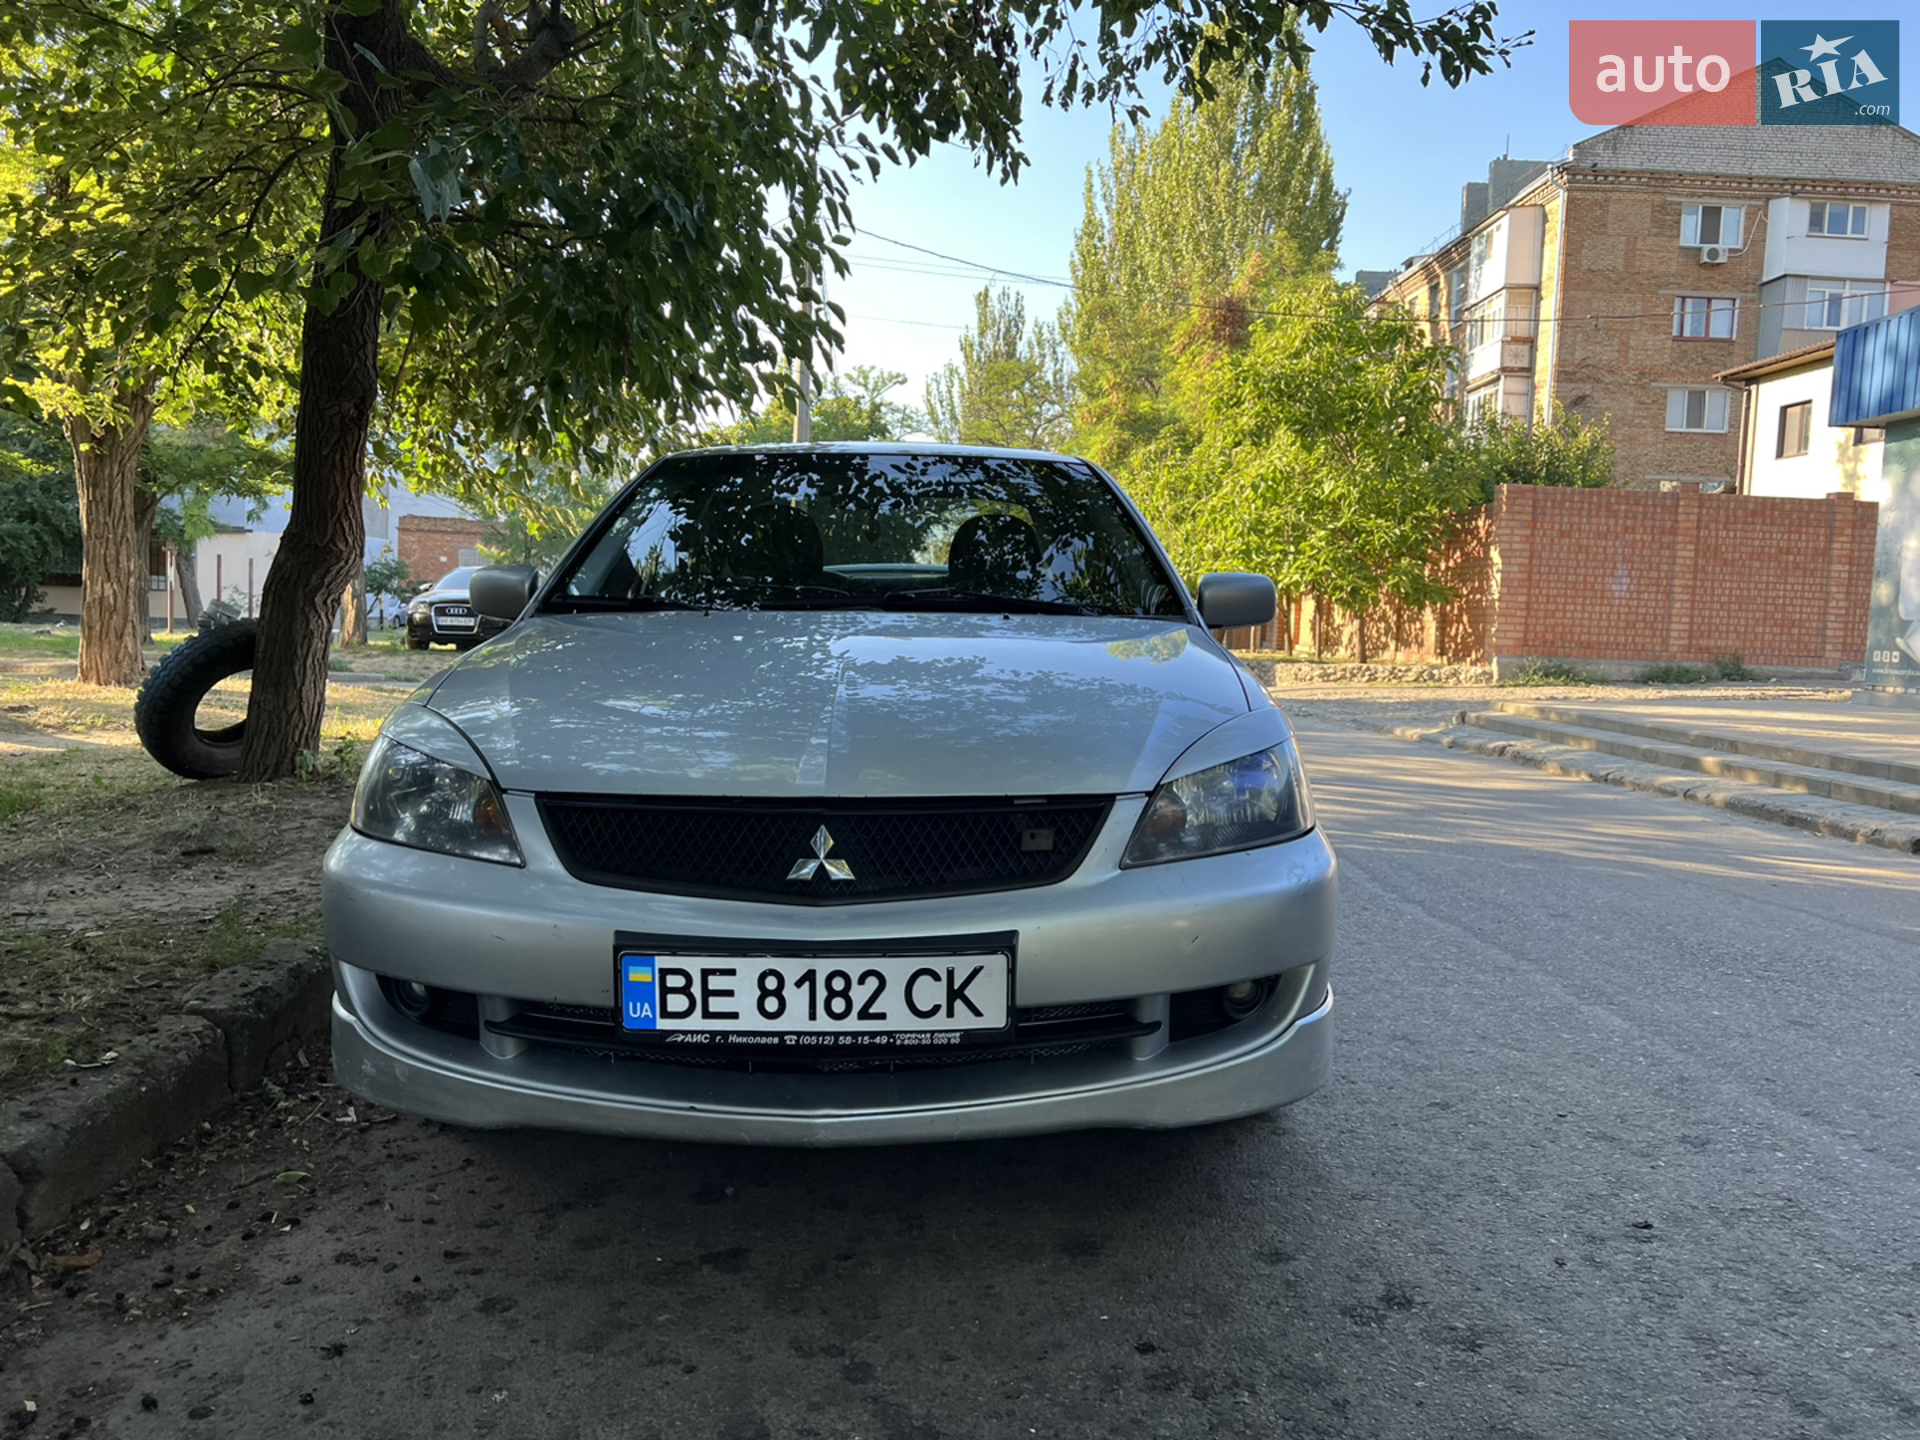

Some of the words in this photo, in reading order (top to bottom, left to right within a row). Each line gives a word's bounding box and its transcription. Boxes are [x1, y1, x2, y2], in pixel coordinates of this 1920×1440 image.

[658, 967, 739, 1021] BE
[756, 968, 888, 1022] 8182
[904, 965, 985, 1020] CK
[629, 1002, 653, 1019] UA
[715, 1035, 724, 1043] г.
[728, 1034, 780, 1045] Николаев
[799, 1034, 834, 1046] (0512)
[838, 1035, 888, 1045] 58-15-49
